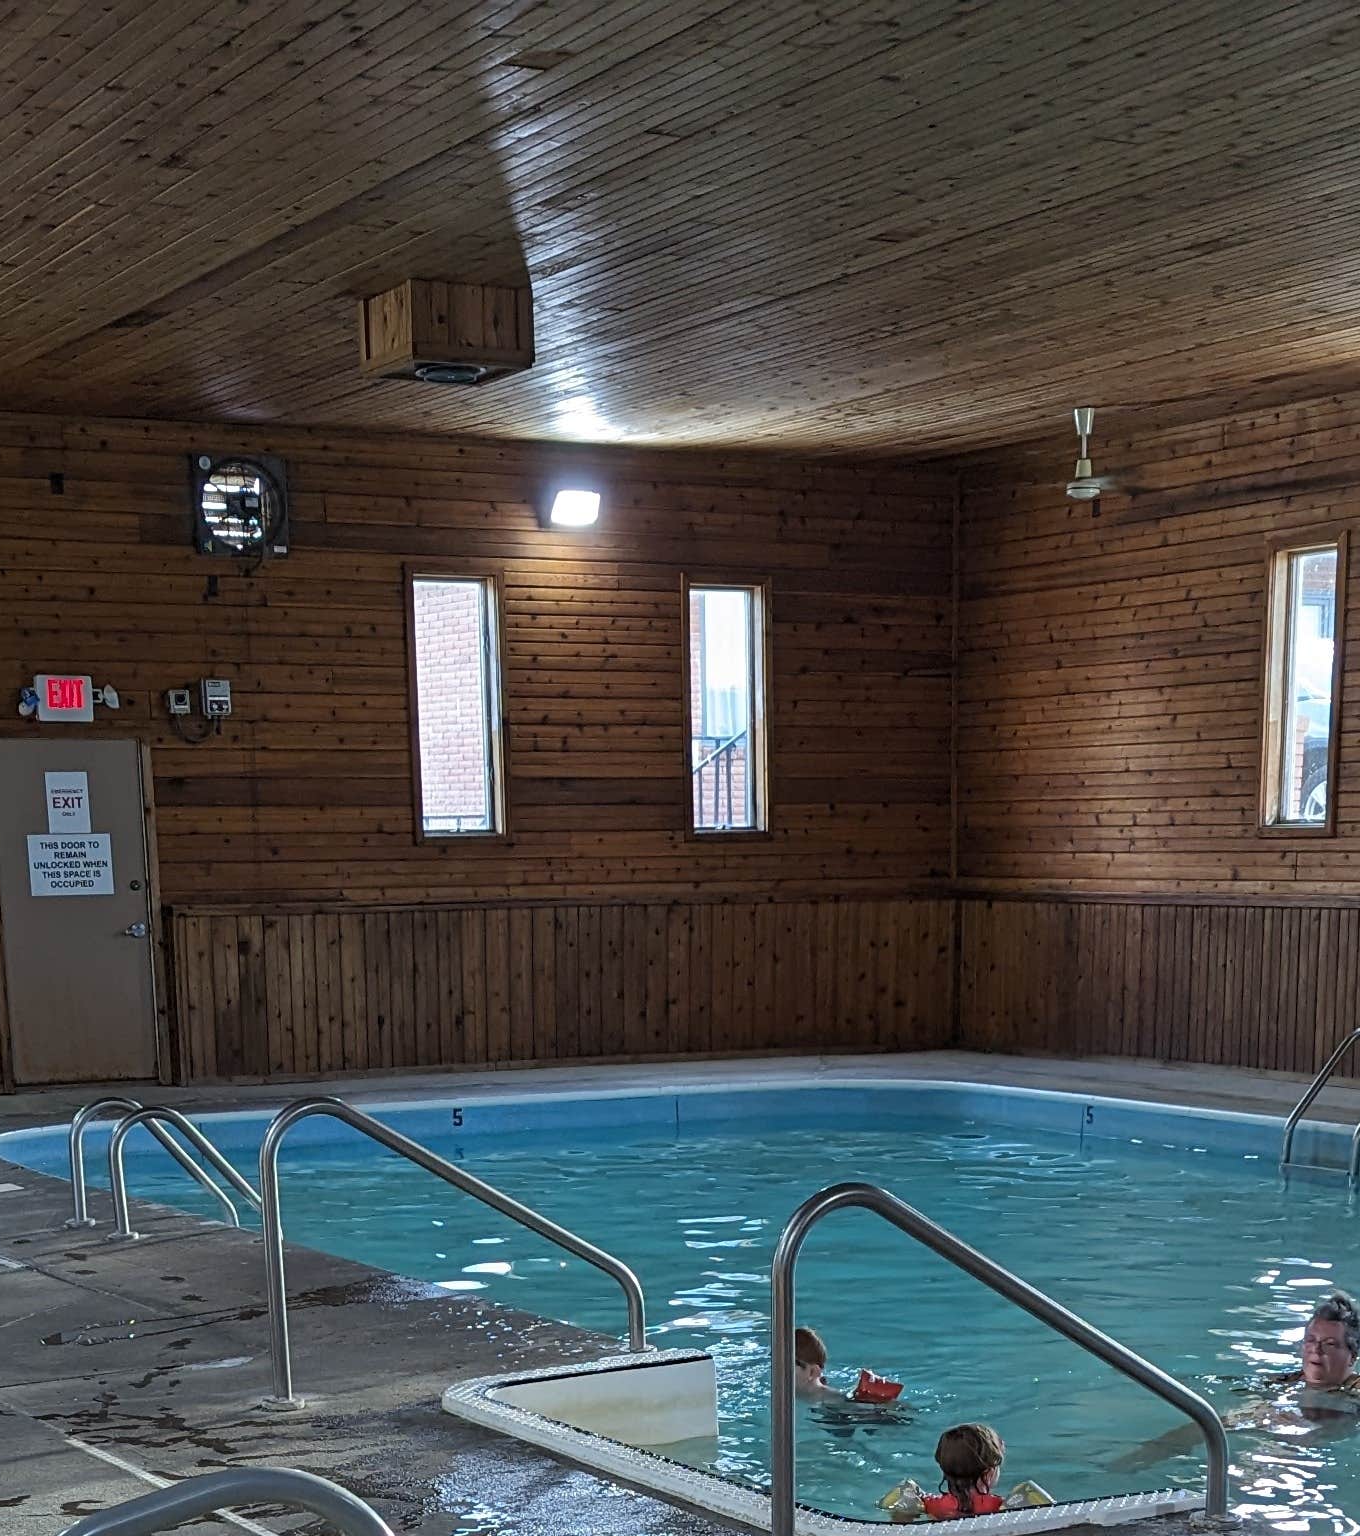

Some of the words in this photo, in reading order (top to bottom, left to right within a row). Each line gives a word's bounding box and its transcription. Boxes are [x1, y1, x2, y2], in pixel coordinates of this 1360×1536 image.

[47, 679, 84, 709] EXIT
[53, 797, 83, 808] EXIT
[40, 841, 59, 850] THIS
[61, 841, 86, 850] DOOR
[88, 841, 100, 849] TO
[54, 851, 87, 859] REMAIN
[33, 861, 81, 869] UNLOCKED
[83, 860, 108, 868] WHEN
[42, 871, 61, 879] THIS
[63, 870, 91, 878] SPACE
[50, 879, 94, 888] OCCUPIED
[453, 1107, 463, 1126] 5
[1086, 1106, 1094, 1124] 5
